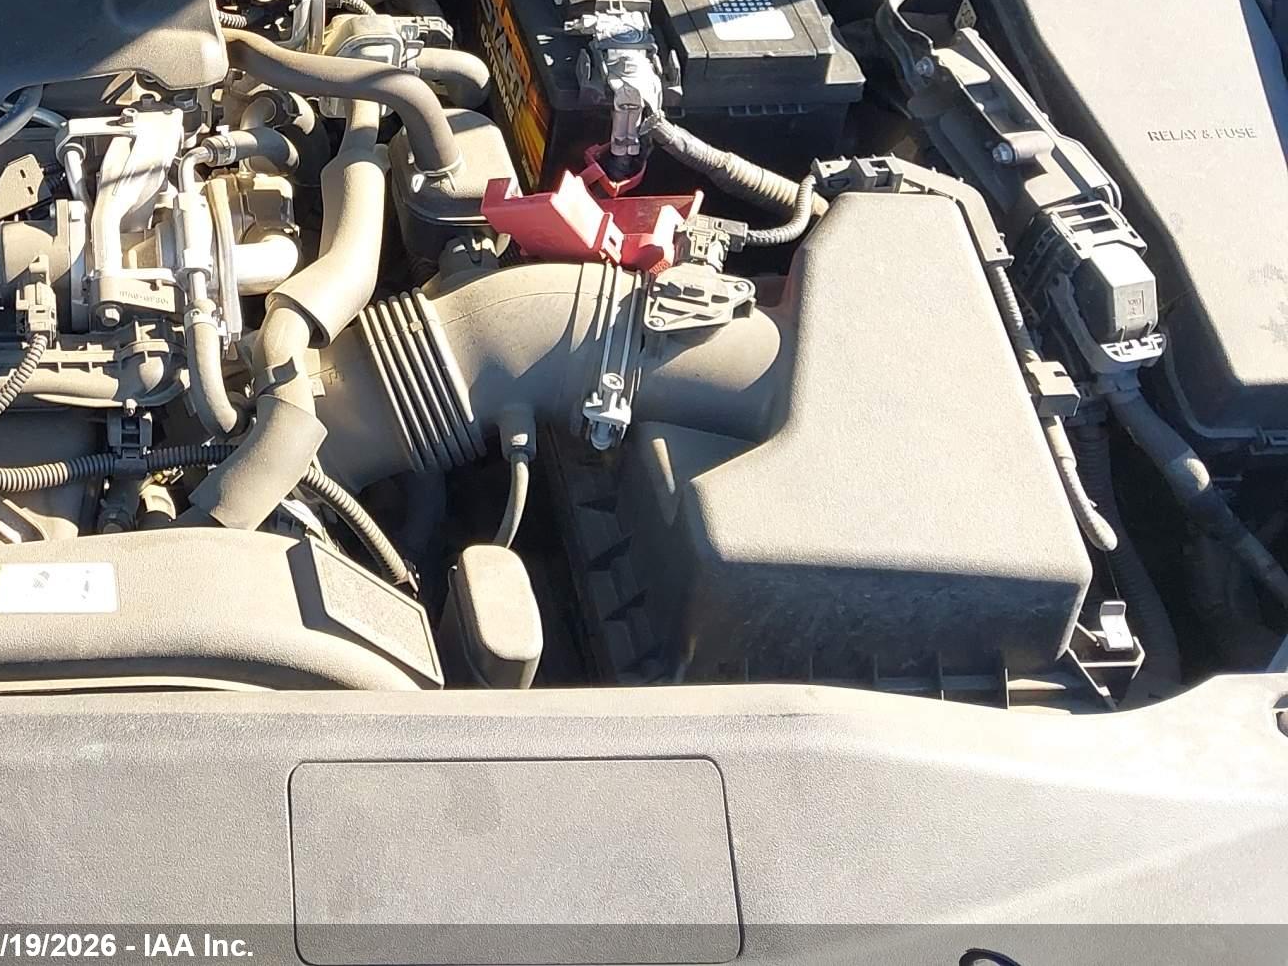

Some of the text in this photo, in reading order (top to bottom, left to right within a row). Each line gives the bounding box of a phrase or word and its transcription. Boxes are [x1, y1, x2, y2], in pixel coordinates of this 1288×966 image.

[480, 22, 515, 124] EXTREME
[1146, 129, 1198, 142] RELAY
[1215, 127, 1258, 139] FUSE
